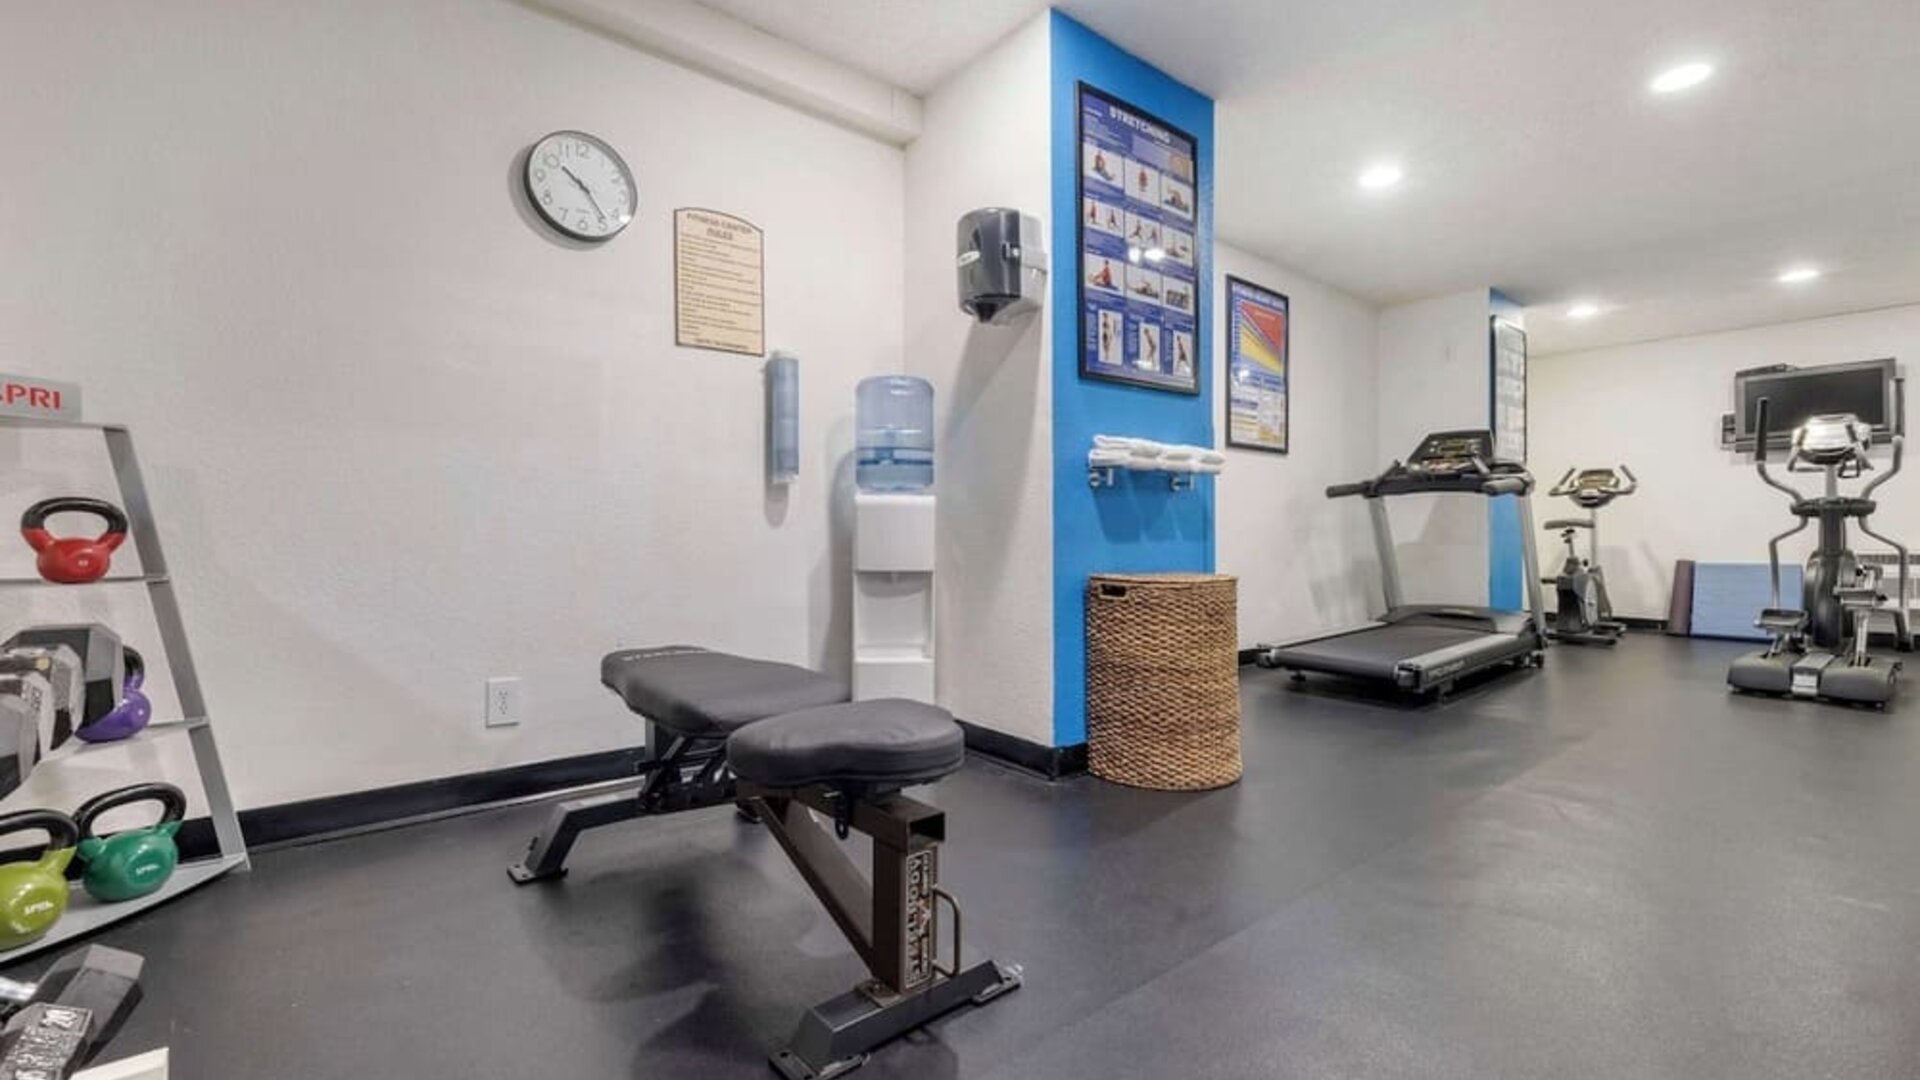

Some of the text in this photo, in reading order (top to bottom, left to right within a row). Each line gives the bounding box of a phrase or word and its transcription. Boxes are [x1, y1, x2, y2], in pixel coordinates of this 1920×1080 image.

[1109, 105, 1171, 143] STRETCHING
[575, 142, 591, 159] 12
[534, 169, 547, 182] 9
[543, 188, 553, 206] 8
[558, 206, 569, 221] 7
[577, 214, 588, 231] 6
[686, 212, 753, 234] FITNESS CENTER
[0, 384, 61, 409] PRI
